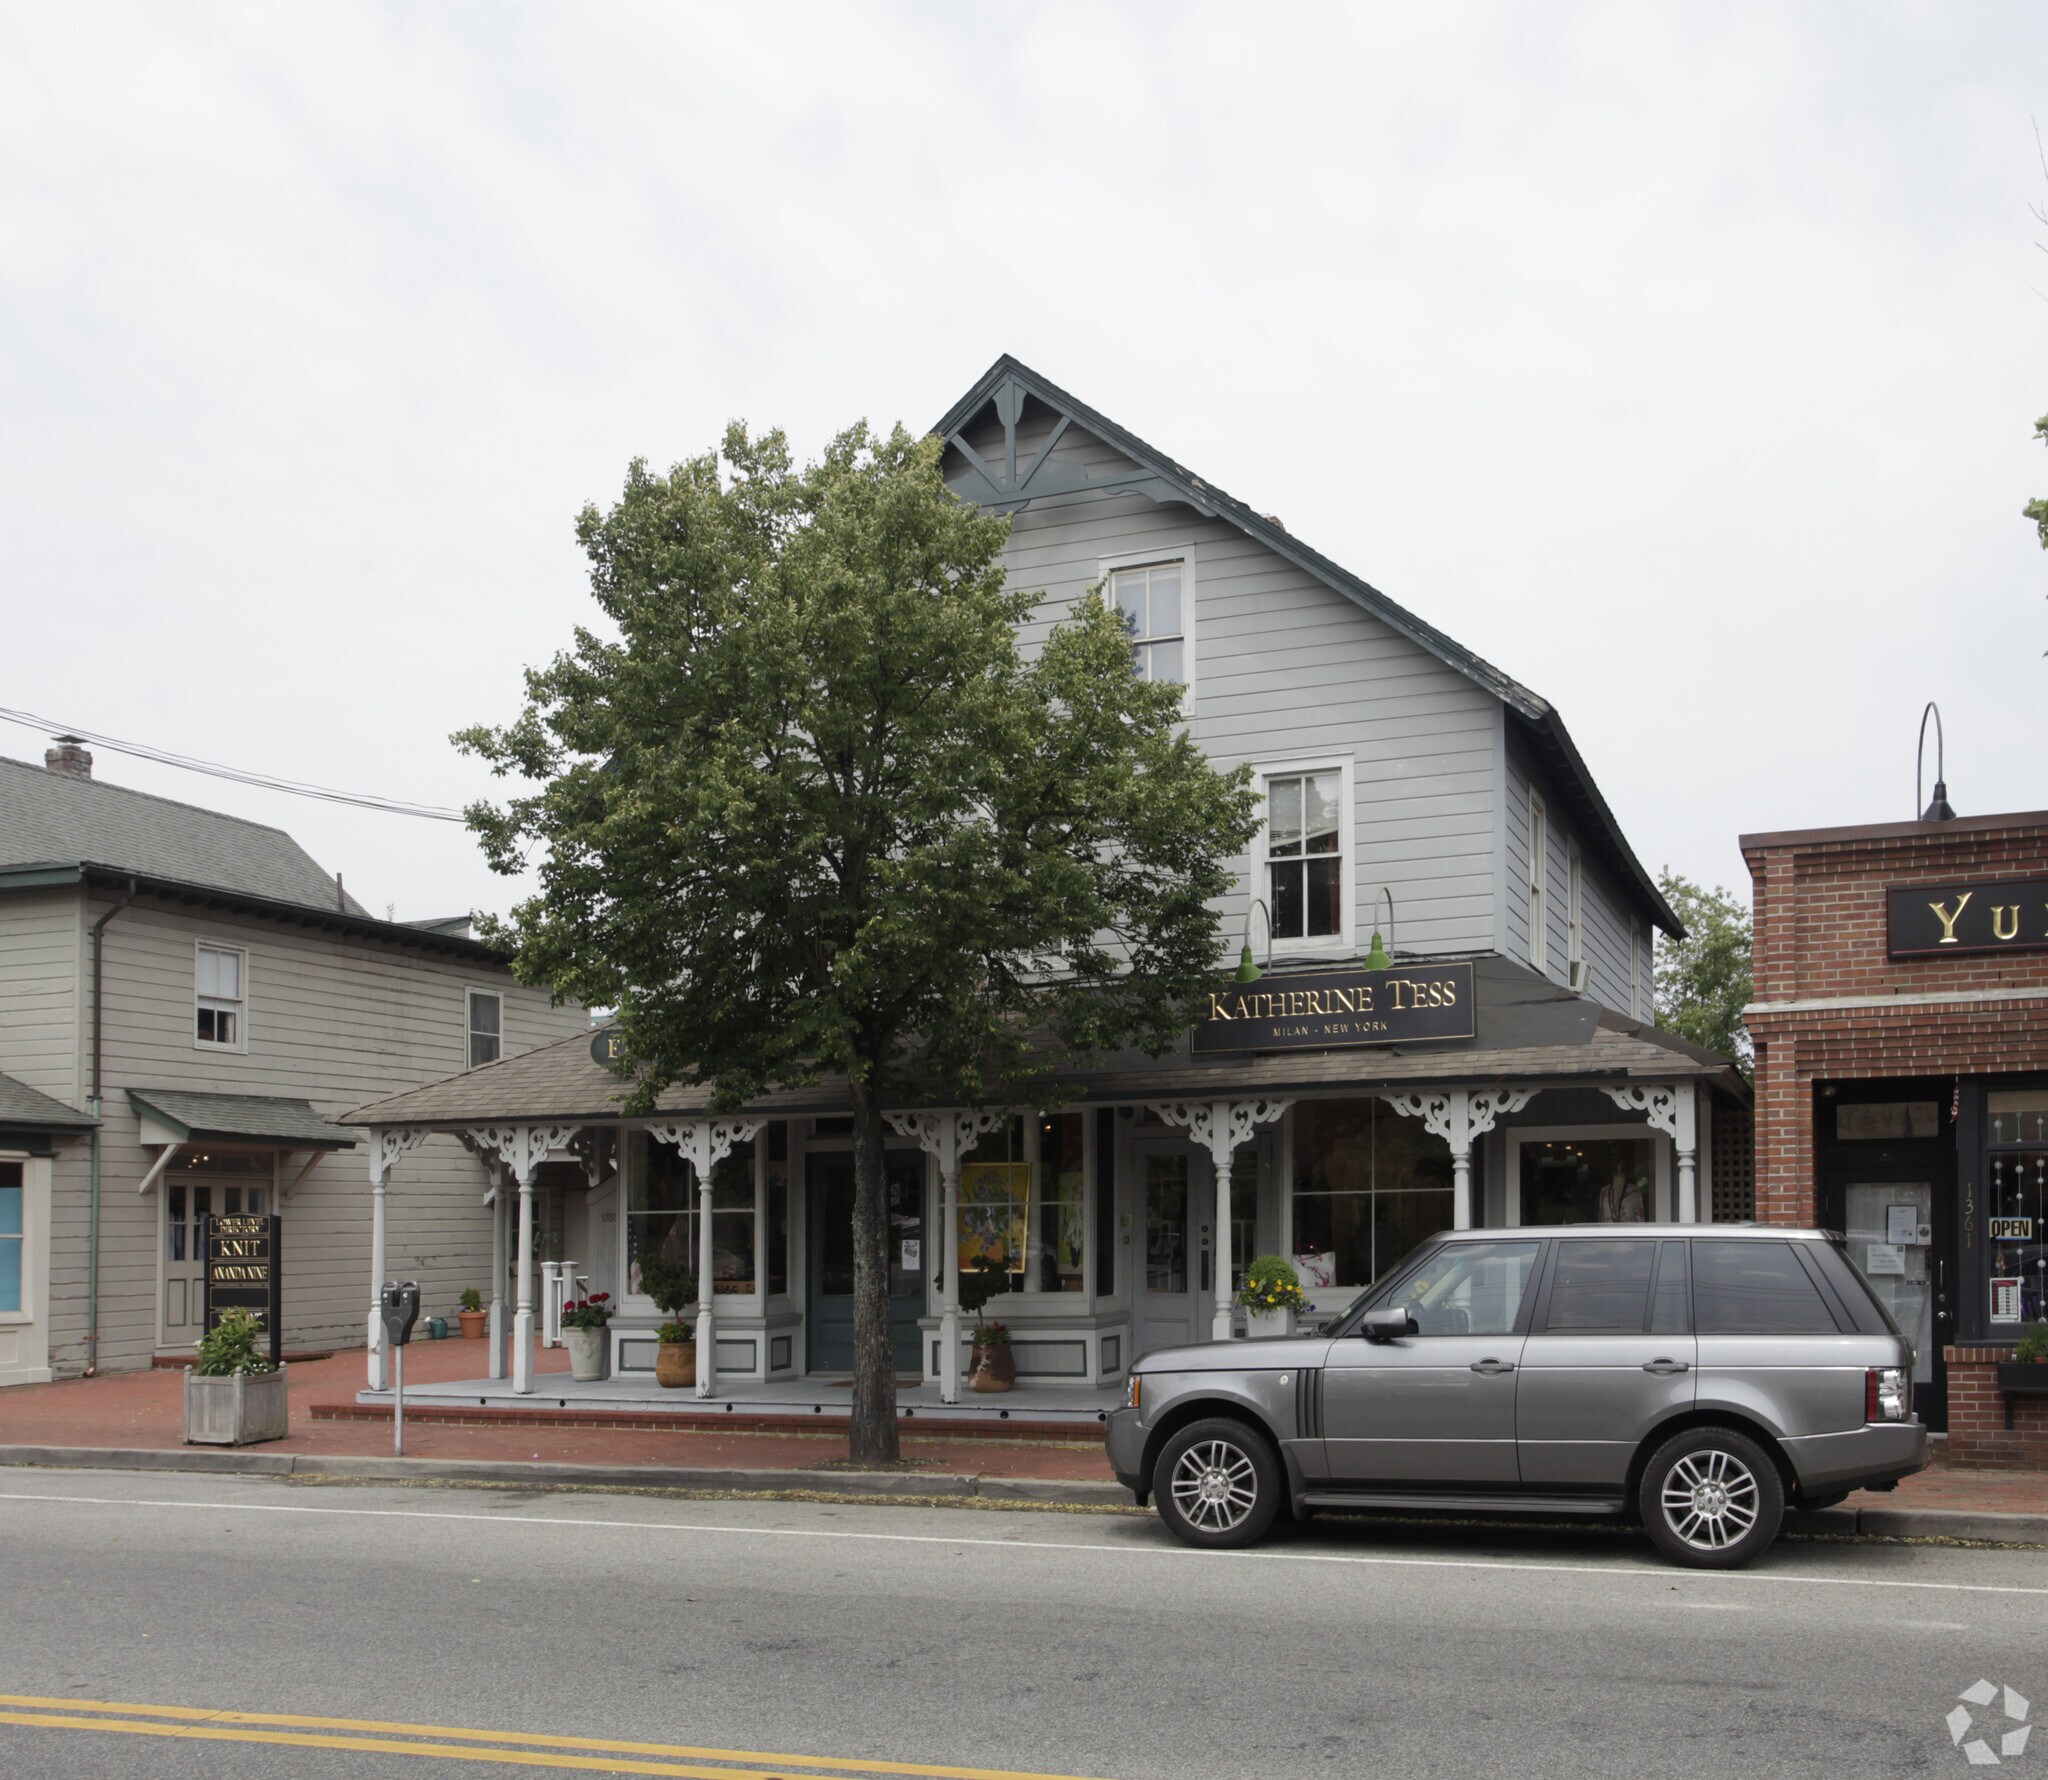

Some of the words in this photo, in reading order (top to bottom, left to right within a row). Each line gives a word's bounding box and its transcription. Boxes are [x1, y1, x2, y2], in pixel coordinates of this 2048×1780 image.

[1928, 891, 2048, 943] YU
[1208, 986, 1375, 1022] KATHERINE
[1385, 979, 1457, 1010] TESS
[1273, 1025, 1309, 1037] MILAN
[1324, 1023, 1350, 1034] NEW
[1354, 1020, 1388, 1033] YORK
[215, 1218, 241, 1226] LOWER
[242, 1218, 265, 1226] LEVEL
[1964, 1182, 1975, 1249] 1361
[1991, 1220, 2029, 1237] OPEN
[220, 1240, 261, 1256] KNIT
[213, 1266, 246, 1280] ANANDA
[247, 1266, 268, 1280] NINE
